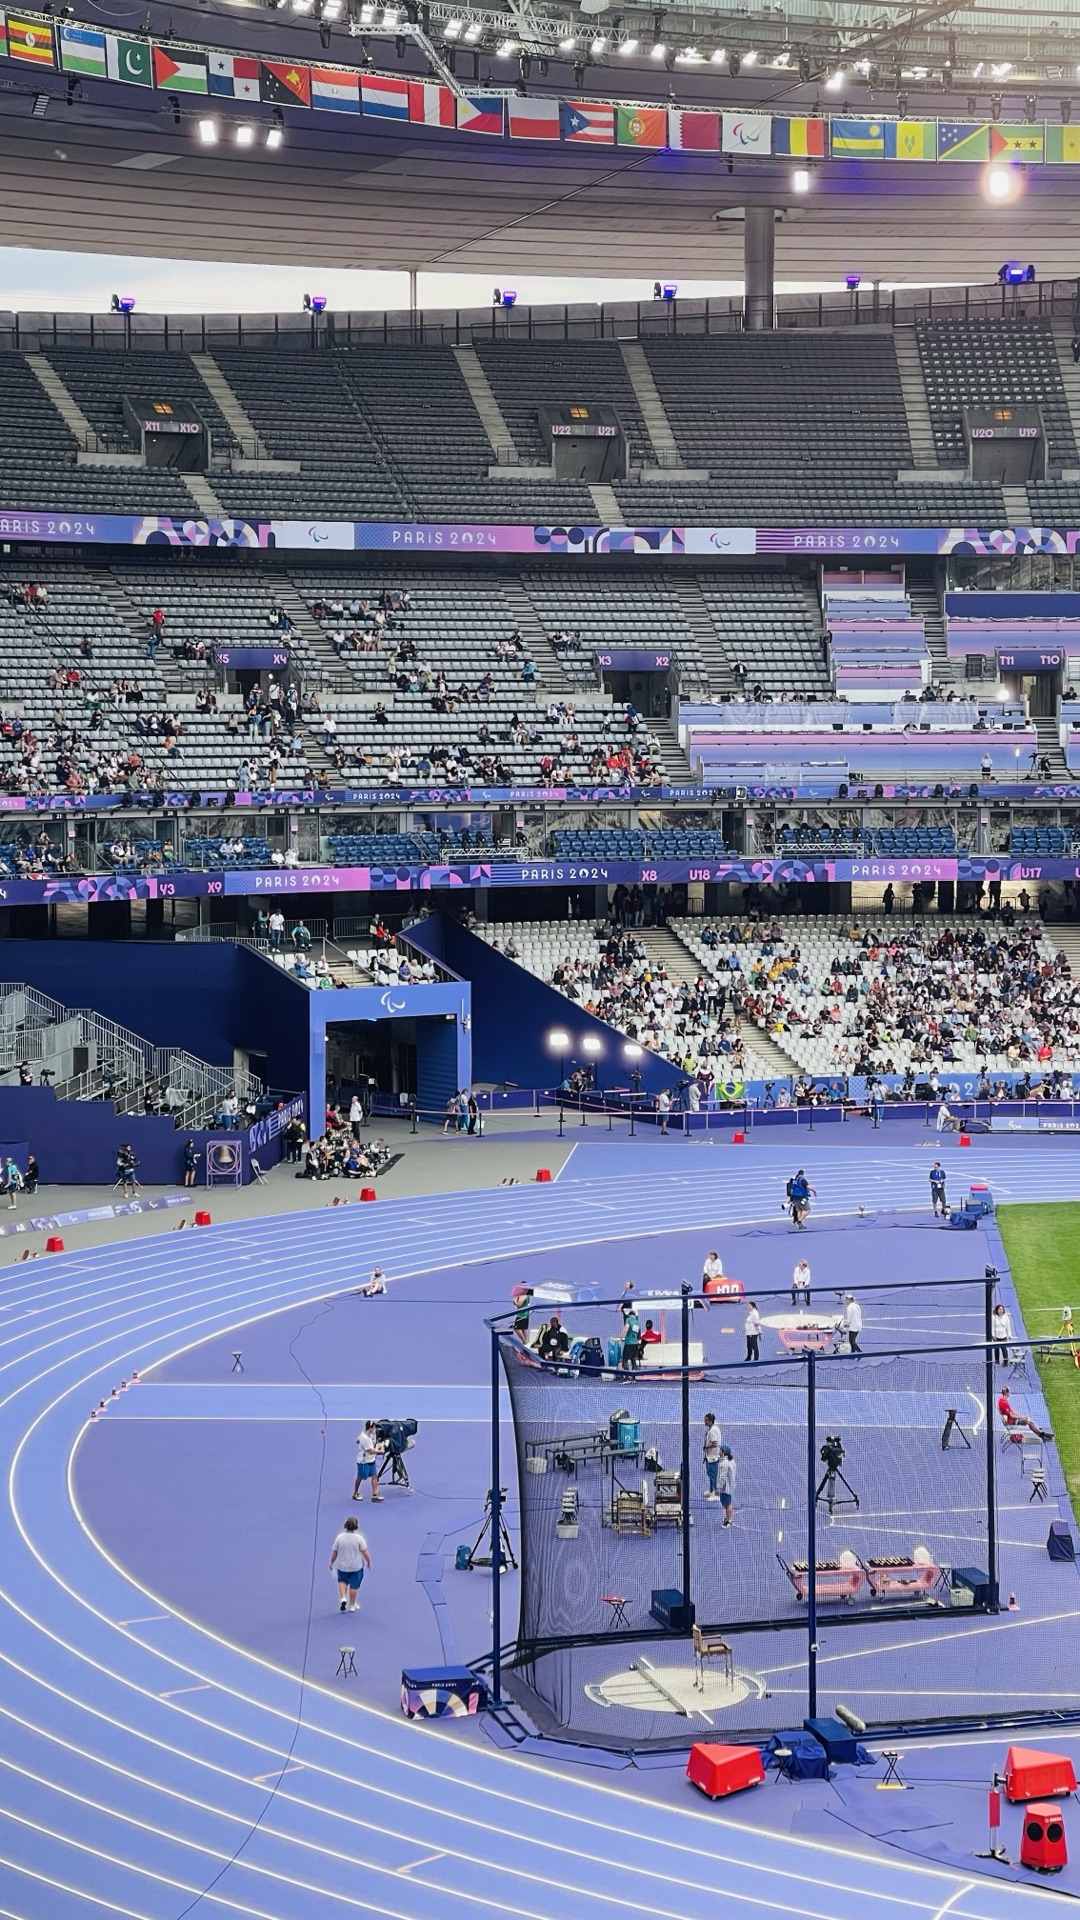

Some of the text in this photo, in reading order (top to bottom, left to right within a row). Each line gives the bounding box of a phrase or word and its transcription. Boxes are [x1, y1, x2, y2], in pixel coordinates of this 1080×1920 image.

[145, 421, 160, 431] X11
[180, 423, 199, 433] X10
[552, 425, 571, 435] U22
[598, 426, 615, 436] U21
[972, 429, 994, 438] U20
[1019, 427, 1037, 437] U19
[0, 519, 94, 535] ARIS 2024
[392, 531, 496, 545] PARIS 2024
[794, 535, 899, 548] PARIS 2024
[273, 654, 287, 664] X4
[598, 655, 612, 666] X3
[655, 656, 669, 666] X2
[1000, 655, 1014, 665] T11
[1040, 655, 1060, 665] T10
[379, 792, 401, 800] 2024
[521, 868, 608, 880] PARIS 2024
[689, 869, 710, 881] U18
[852, 864, 941, 876] PARIS 2024
[1021, 867, 1042, 878] U17
[642, 870, 657, 881] X8
[255, 875, 340, 889] PARIS 2024
[208, 882, 222, 894] X9
